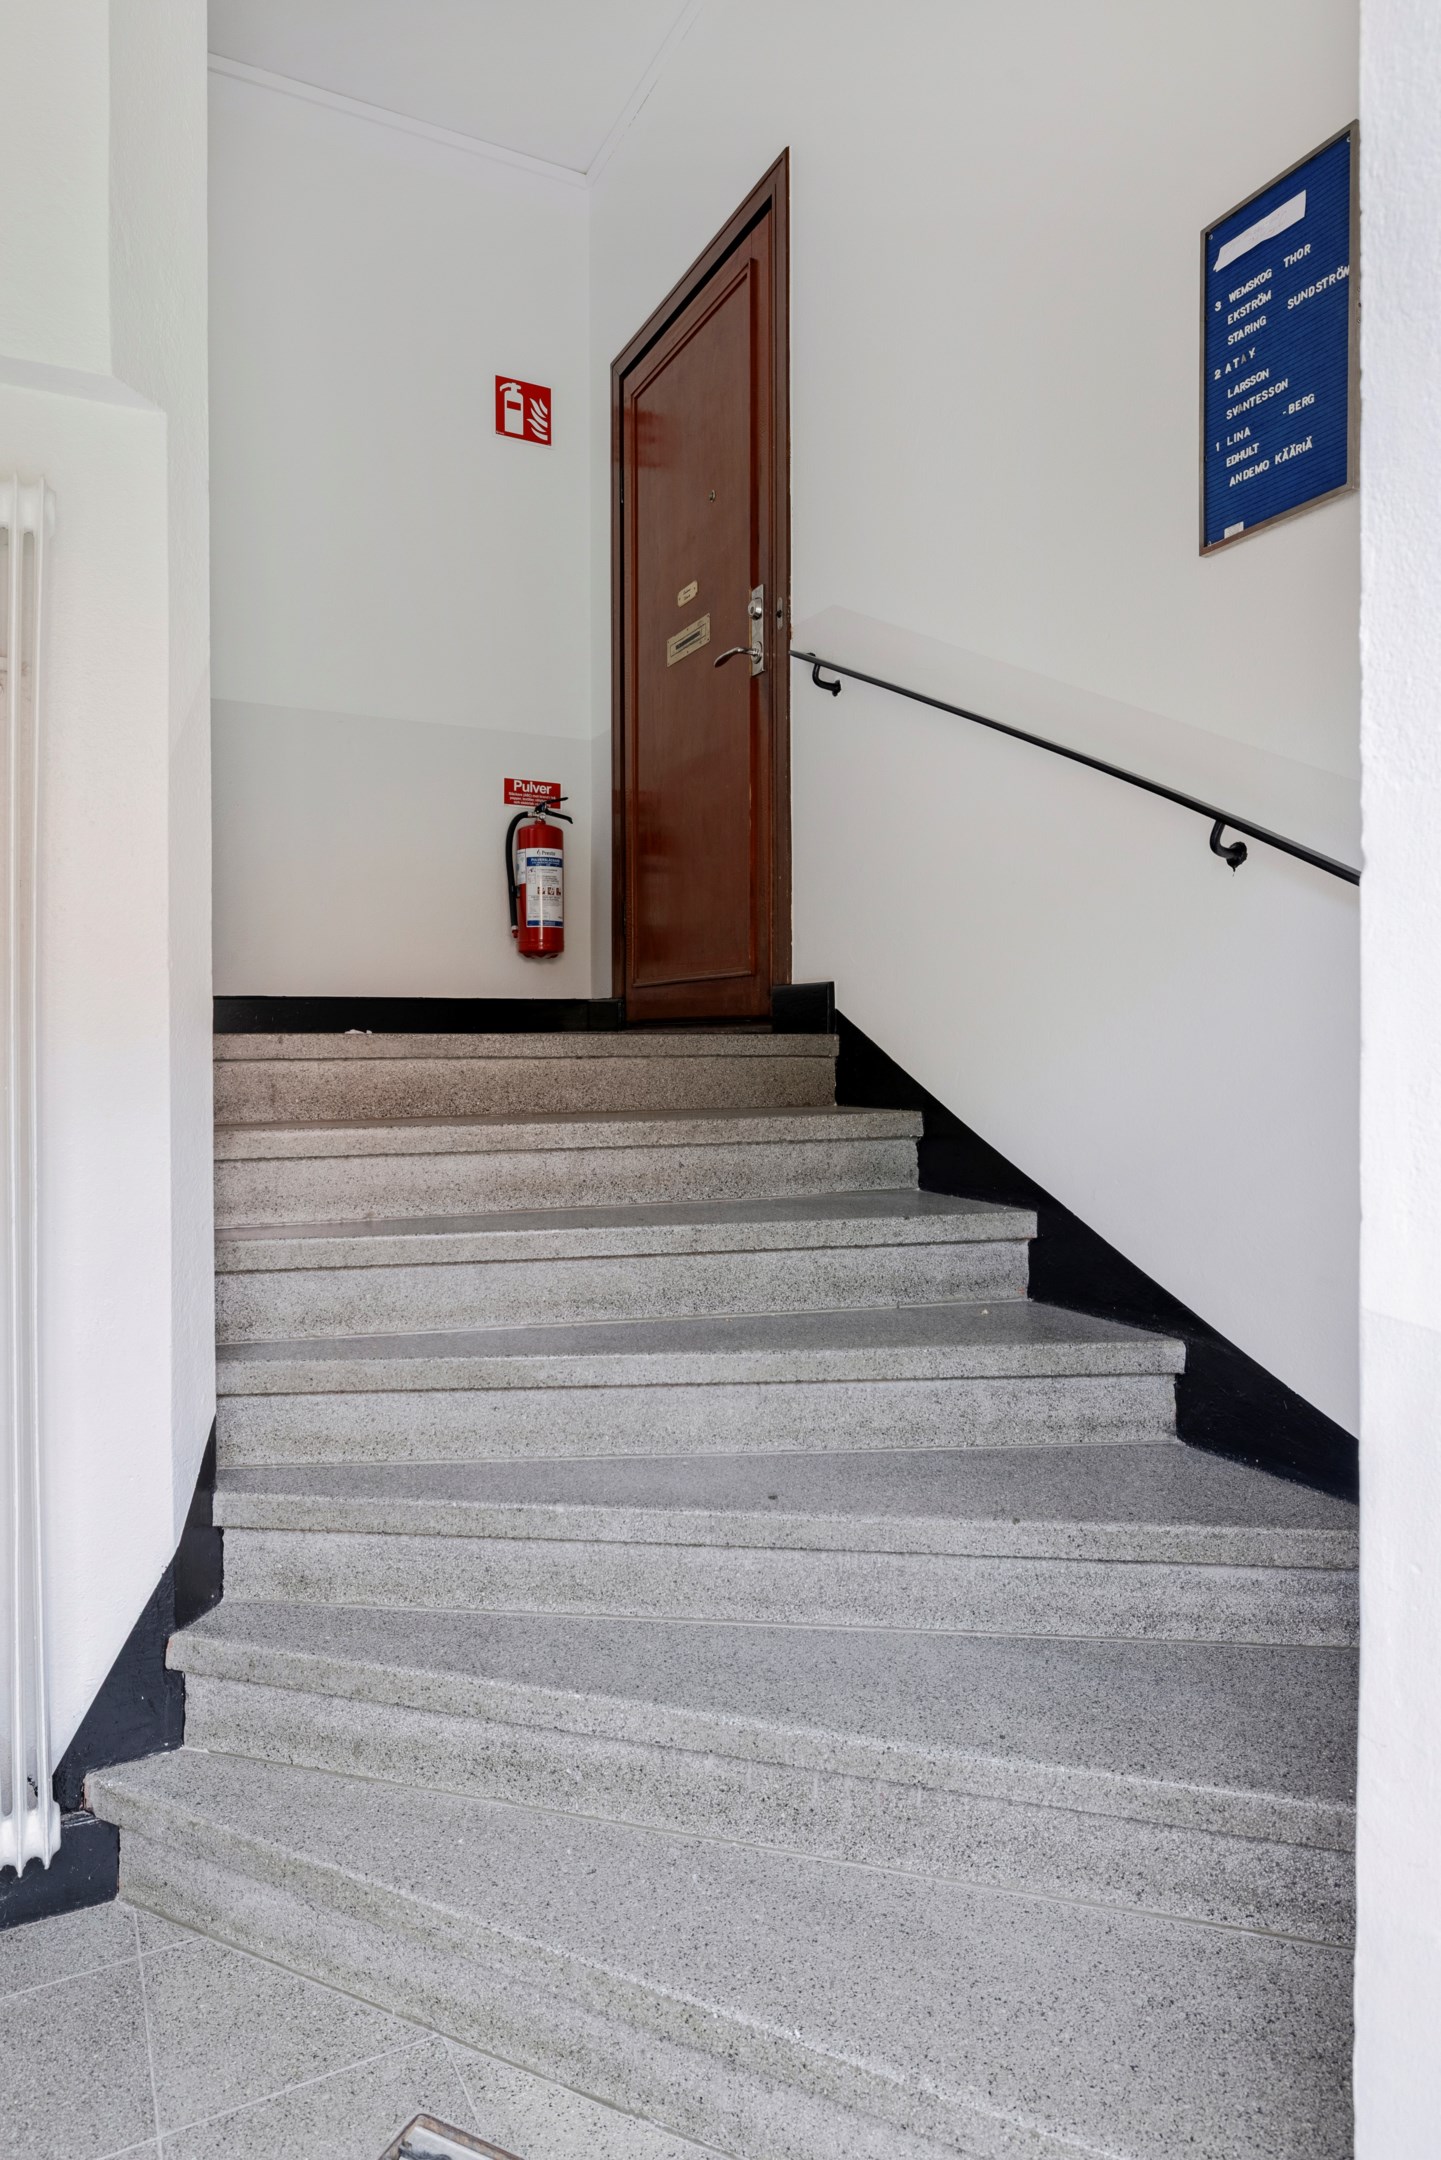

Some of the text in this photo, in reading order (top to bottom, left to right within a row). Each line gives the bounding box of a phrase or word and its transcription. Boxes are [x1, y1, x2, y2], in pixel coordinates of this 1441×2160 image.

[1214, 243, 1312, 312] 3 WEMSKOG THOR
[1227, 290, 1272, 325] EKSTRÖM
[1227, 315, 1267, 346] STARING
[1214, 368, 1222, 380] 2
[1227, 368, 1270, 399] LARSSON
[1226, 378, 1289, 420] SVANTESSON
[1215, 441, 1220, 452] 1
[1226, 426, 1251, 446] LINA
[1226, 442, 1260, 468] EDHULT
[1229, 435, 1313, 487] ANDEMO KÄÄRIÄ
[513, 780, 552, 795] Pulver
